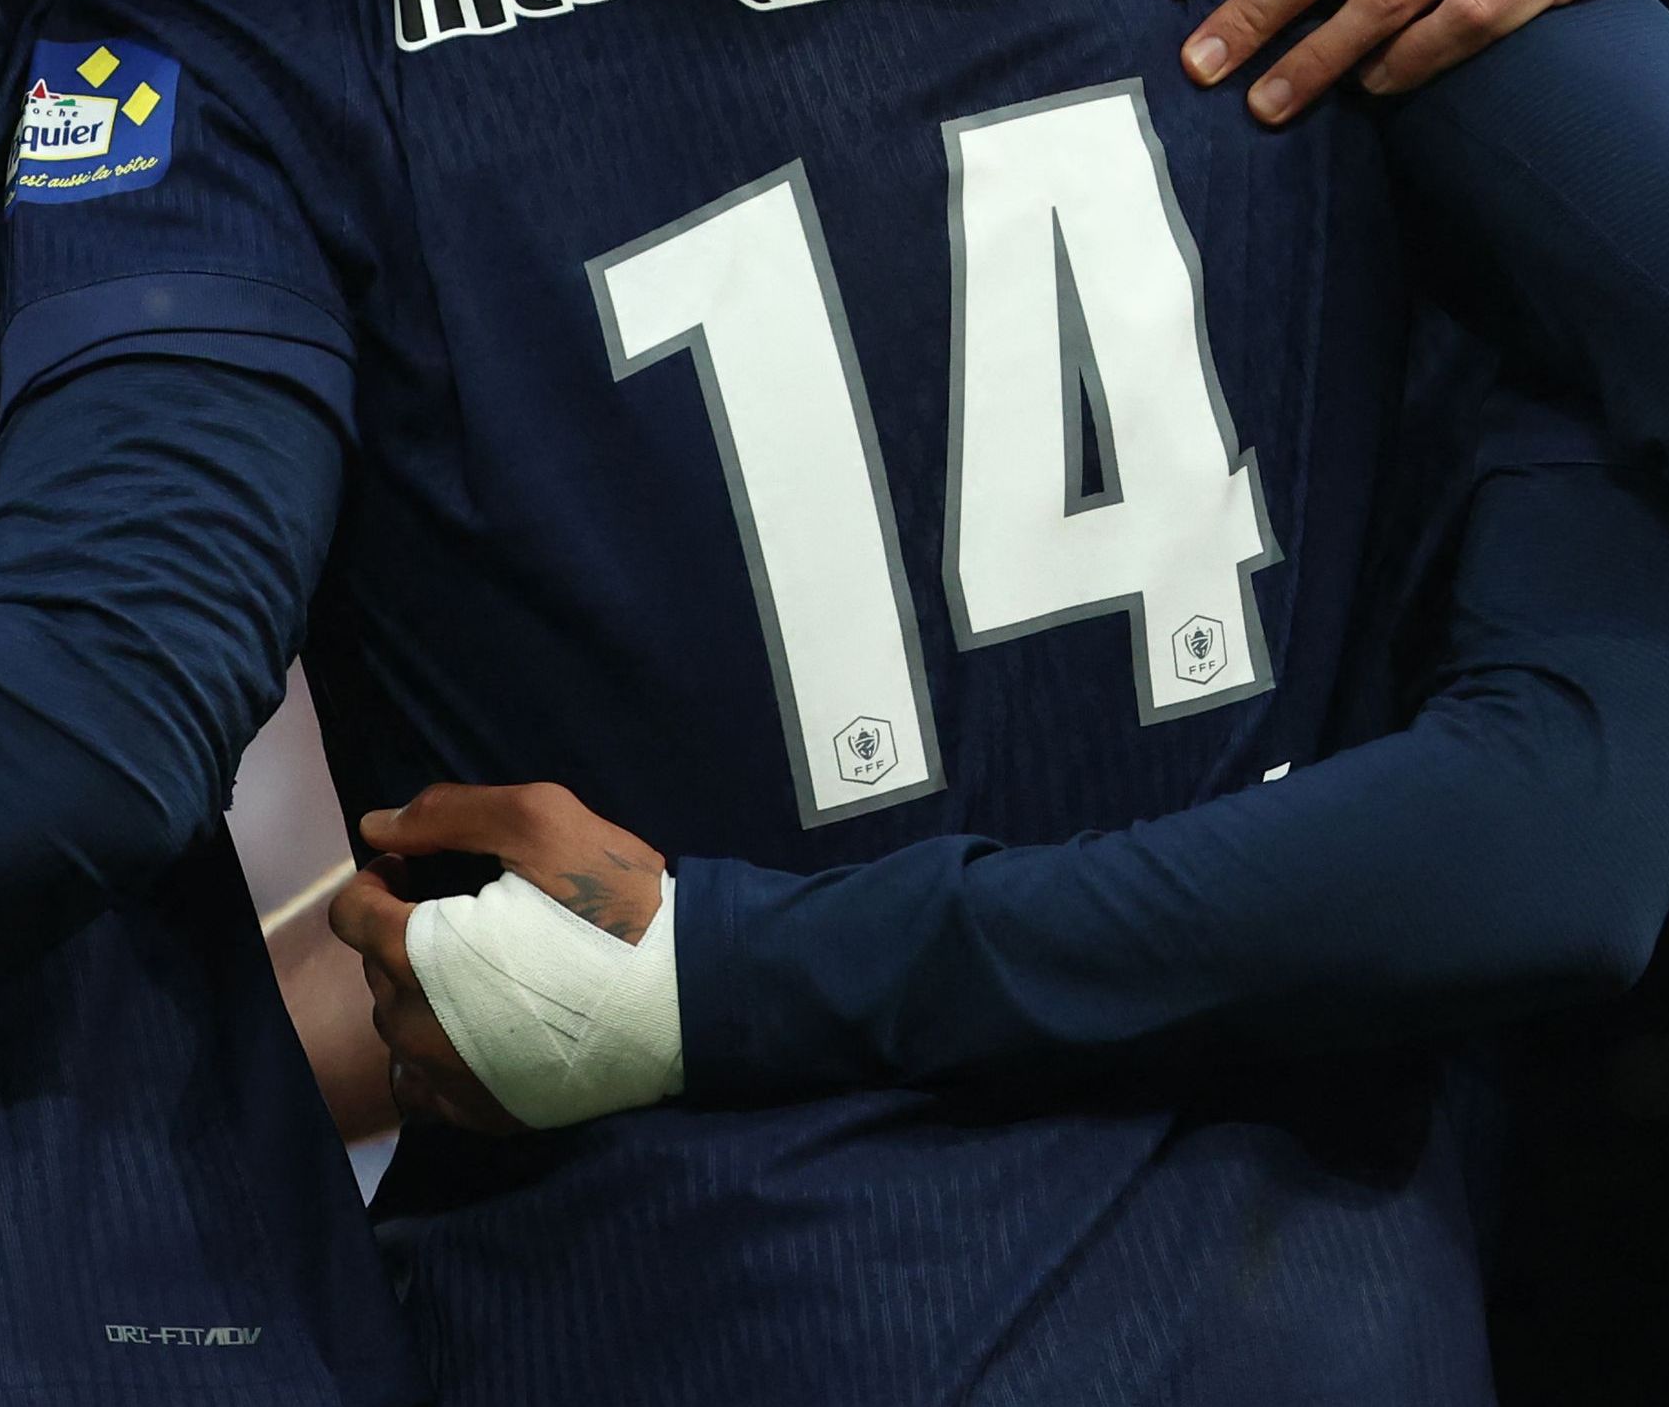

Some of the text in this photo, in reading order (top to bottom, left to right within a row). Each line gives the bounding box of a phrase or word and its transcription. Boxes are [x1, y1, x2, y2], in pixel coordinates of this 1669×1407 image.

[91, 164, 113, 181] la
[583, 76, 1285, 829] 14
[1189, 660, 1216, 676] FFF
[854, 760, 885, 777] FFF
